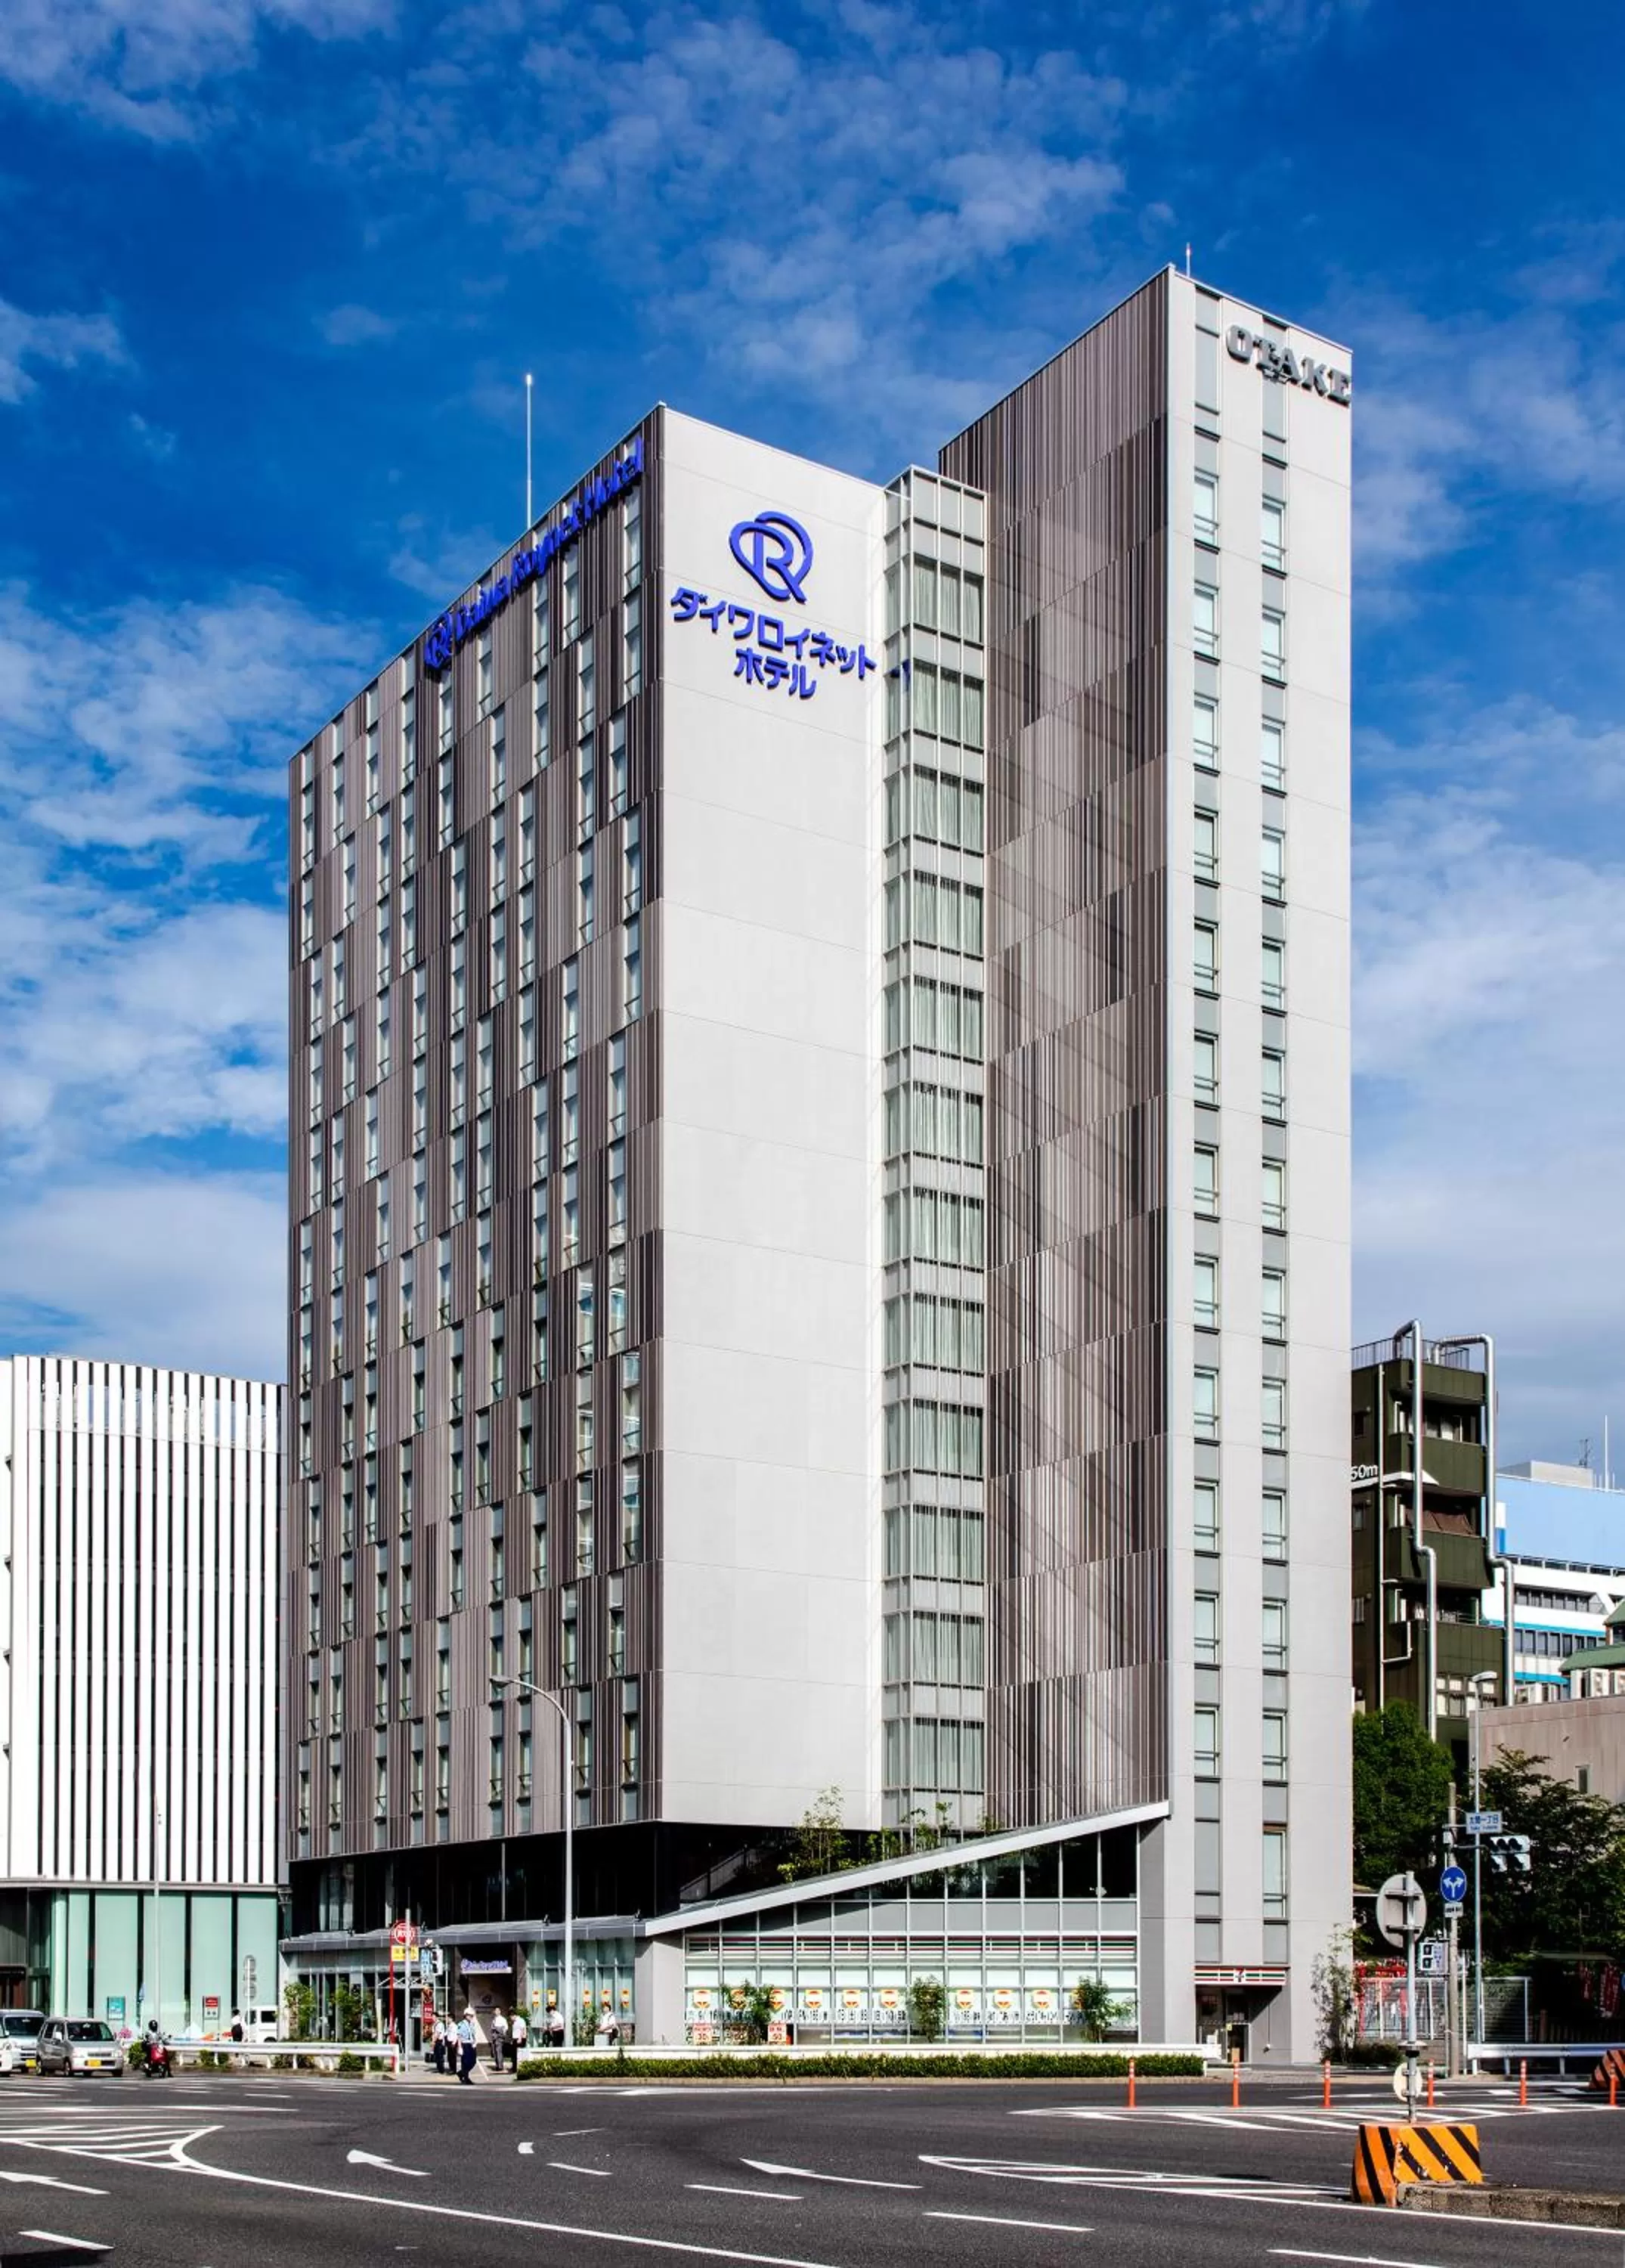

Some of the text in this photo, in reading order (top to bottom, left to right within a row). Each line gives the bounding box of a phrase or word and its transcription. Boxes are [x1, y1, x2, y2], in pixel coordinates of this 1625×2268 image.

[1225, 325, 1351, 408] OTAKE
[670, 586, 877, 680] ダイワロイネット
[733, 647, 817, 699] ホテル
